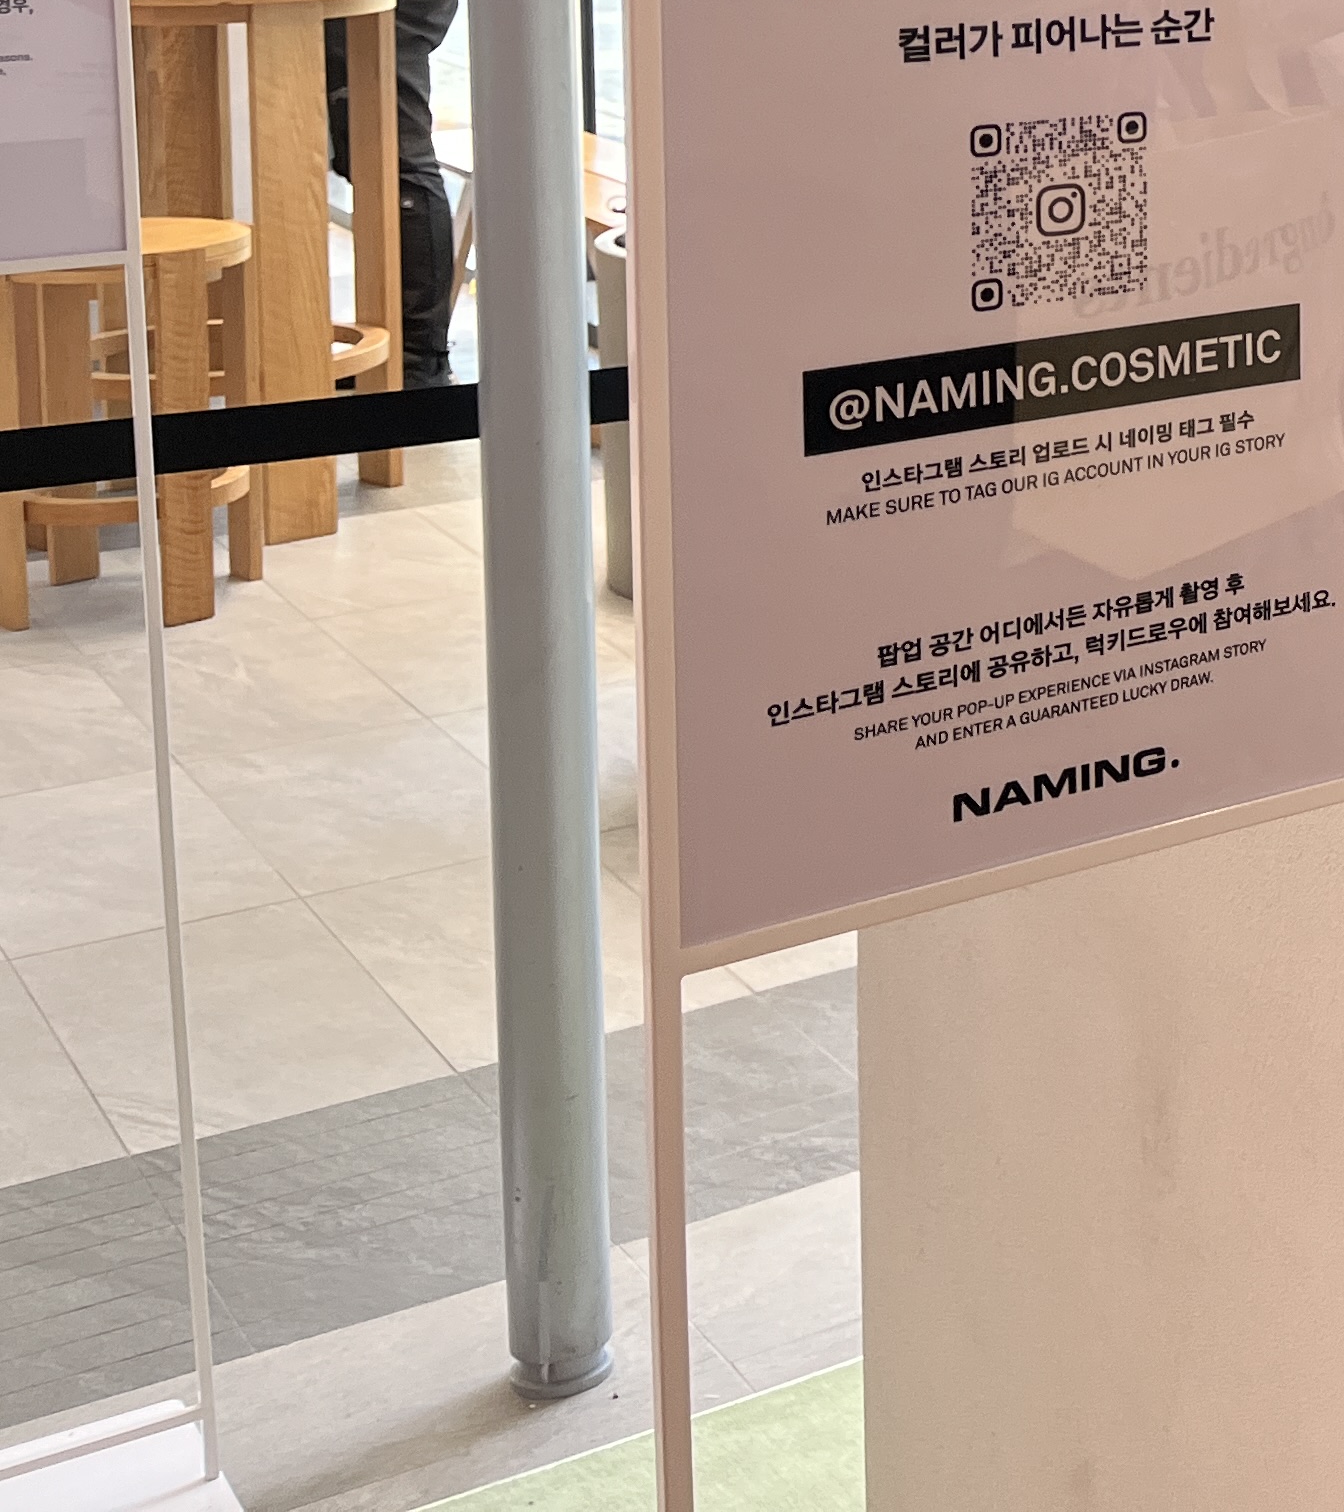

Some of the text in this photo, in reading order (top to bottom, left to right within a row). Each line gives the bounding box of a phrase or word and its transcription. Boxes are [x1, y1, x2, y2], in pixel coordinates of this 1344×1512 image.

[898, 7, 1215, 64] 컬러가 피어나는 순간
[828, 327, 1283, 432] @NAMING.COSMETIC
[826, 432, 1285, 526] MAKE SURE TO TAG OUR IG ACCOUNT IN YOUR IG STORY
[861, 409, 1255, 493] 인스타그램 스토리 업로드 시 네이밍 태그 필수
[767, 589, 1336, 727] 인스타그램 스토리에 공유하고, 럭키드로우에 참여해보세요.
[877, 572, 1245, 669] 팝업 공간 어디에서든 자유롭게 촬영 후
[854, 638, 1267, 741] SHARE YOUR POP-UP EXPERIENCE VIA INSTAGRAM STORY
[914, 670, 1214, 750] AND ENTER A GUARANTEED LUCKY DRAW.
[952, 746, 1180, 823] NAMING.
